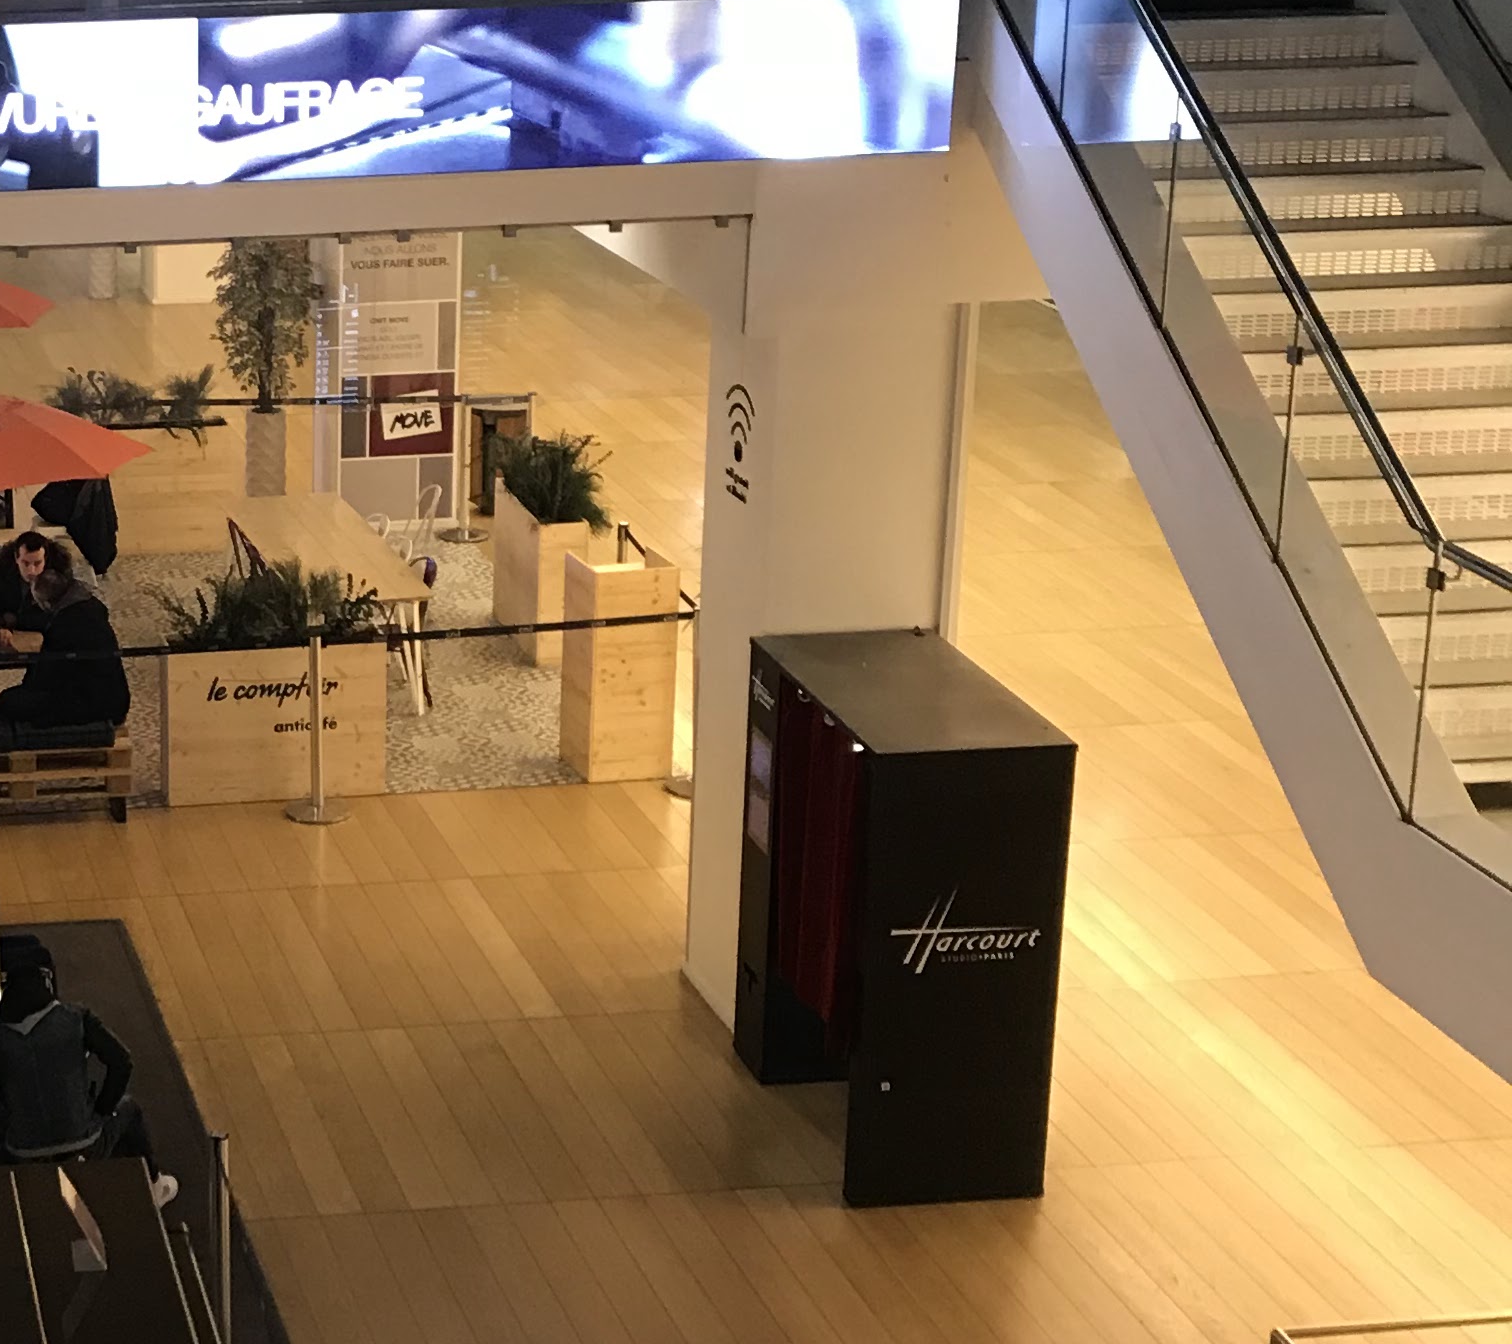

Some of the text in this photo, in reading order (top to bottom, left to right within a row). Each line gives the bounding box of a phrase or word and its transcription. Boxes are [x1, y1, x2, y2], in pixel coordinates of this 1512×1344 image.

[350, 256, 450, 270] VOUS FAIRE SUER.
[390, 409, 435, 434] MOVE
[207, 676, 228, 702] le
[274, 716, 338, 733] anticfé
[890, 882, 1041, 974] Harcourt
